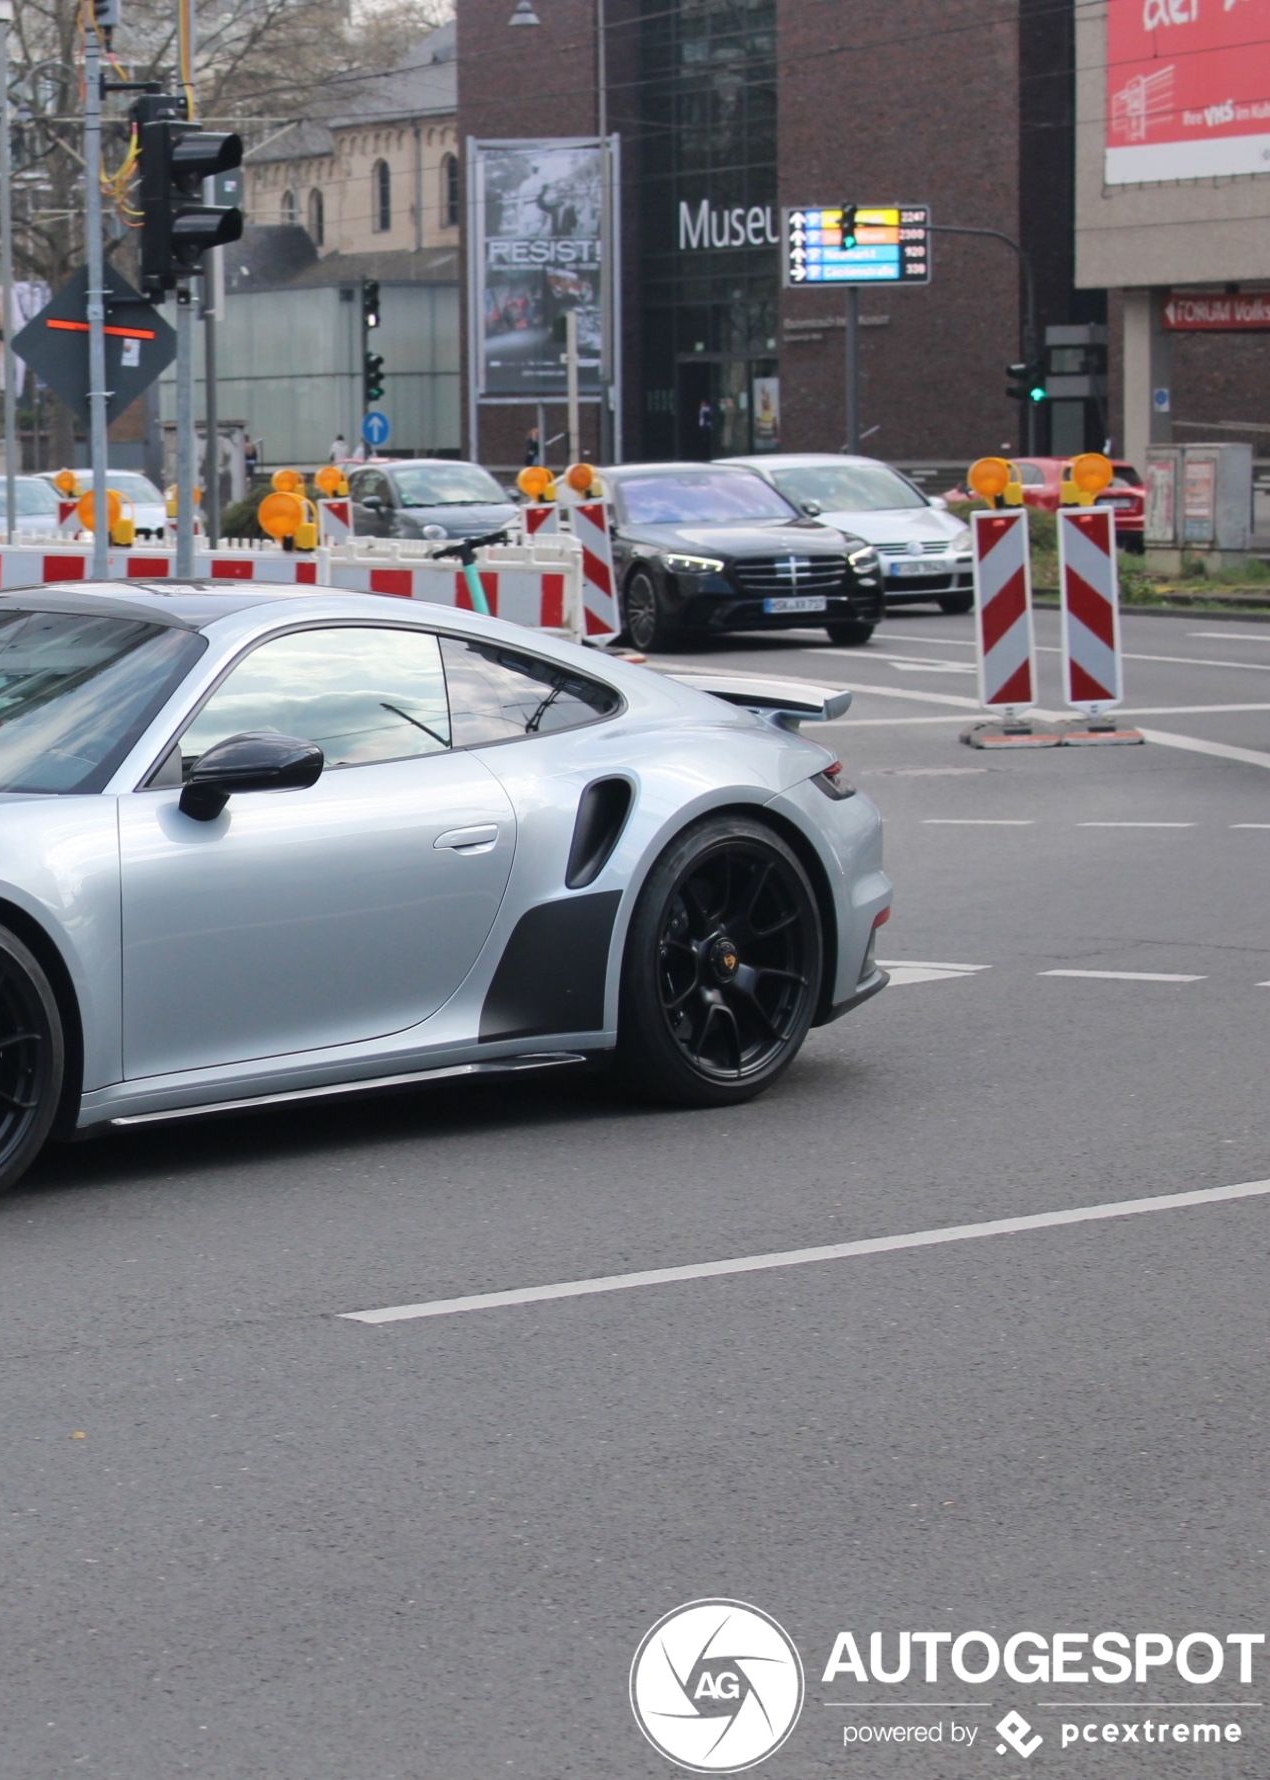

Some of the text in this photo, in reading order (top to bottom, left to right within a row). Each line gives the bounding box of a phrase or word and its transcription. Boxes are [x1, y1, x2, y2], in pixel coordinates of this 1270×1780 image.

[1204, 98, 1234, 127] VHS
[489, 240, 602, 263] RESIST!
[1176, 300, 1231, 322] FORUM
